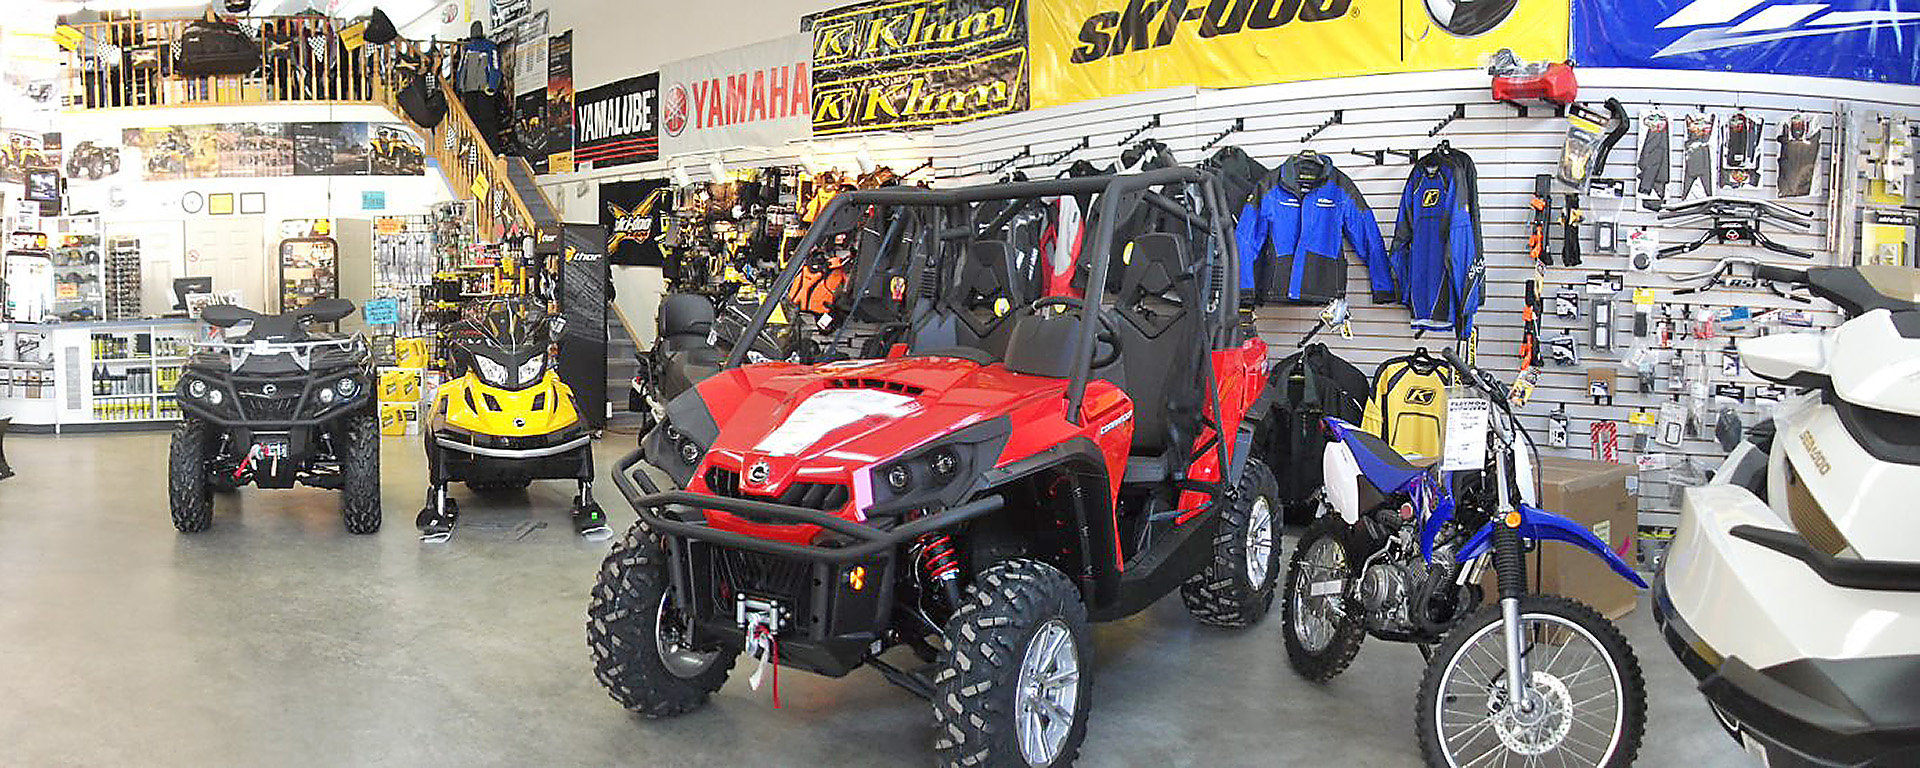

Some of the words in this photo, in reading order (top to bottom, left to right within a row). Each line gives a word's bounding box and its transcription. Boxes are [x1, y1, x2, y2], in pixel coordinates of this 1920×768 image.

[578, 91, 652, 142] YAMALUBE
[691, 62, 811, 129] YAMAHA
[574, 251, 601, 262] thor
